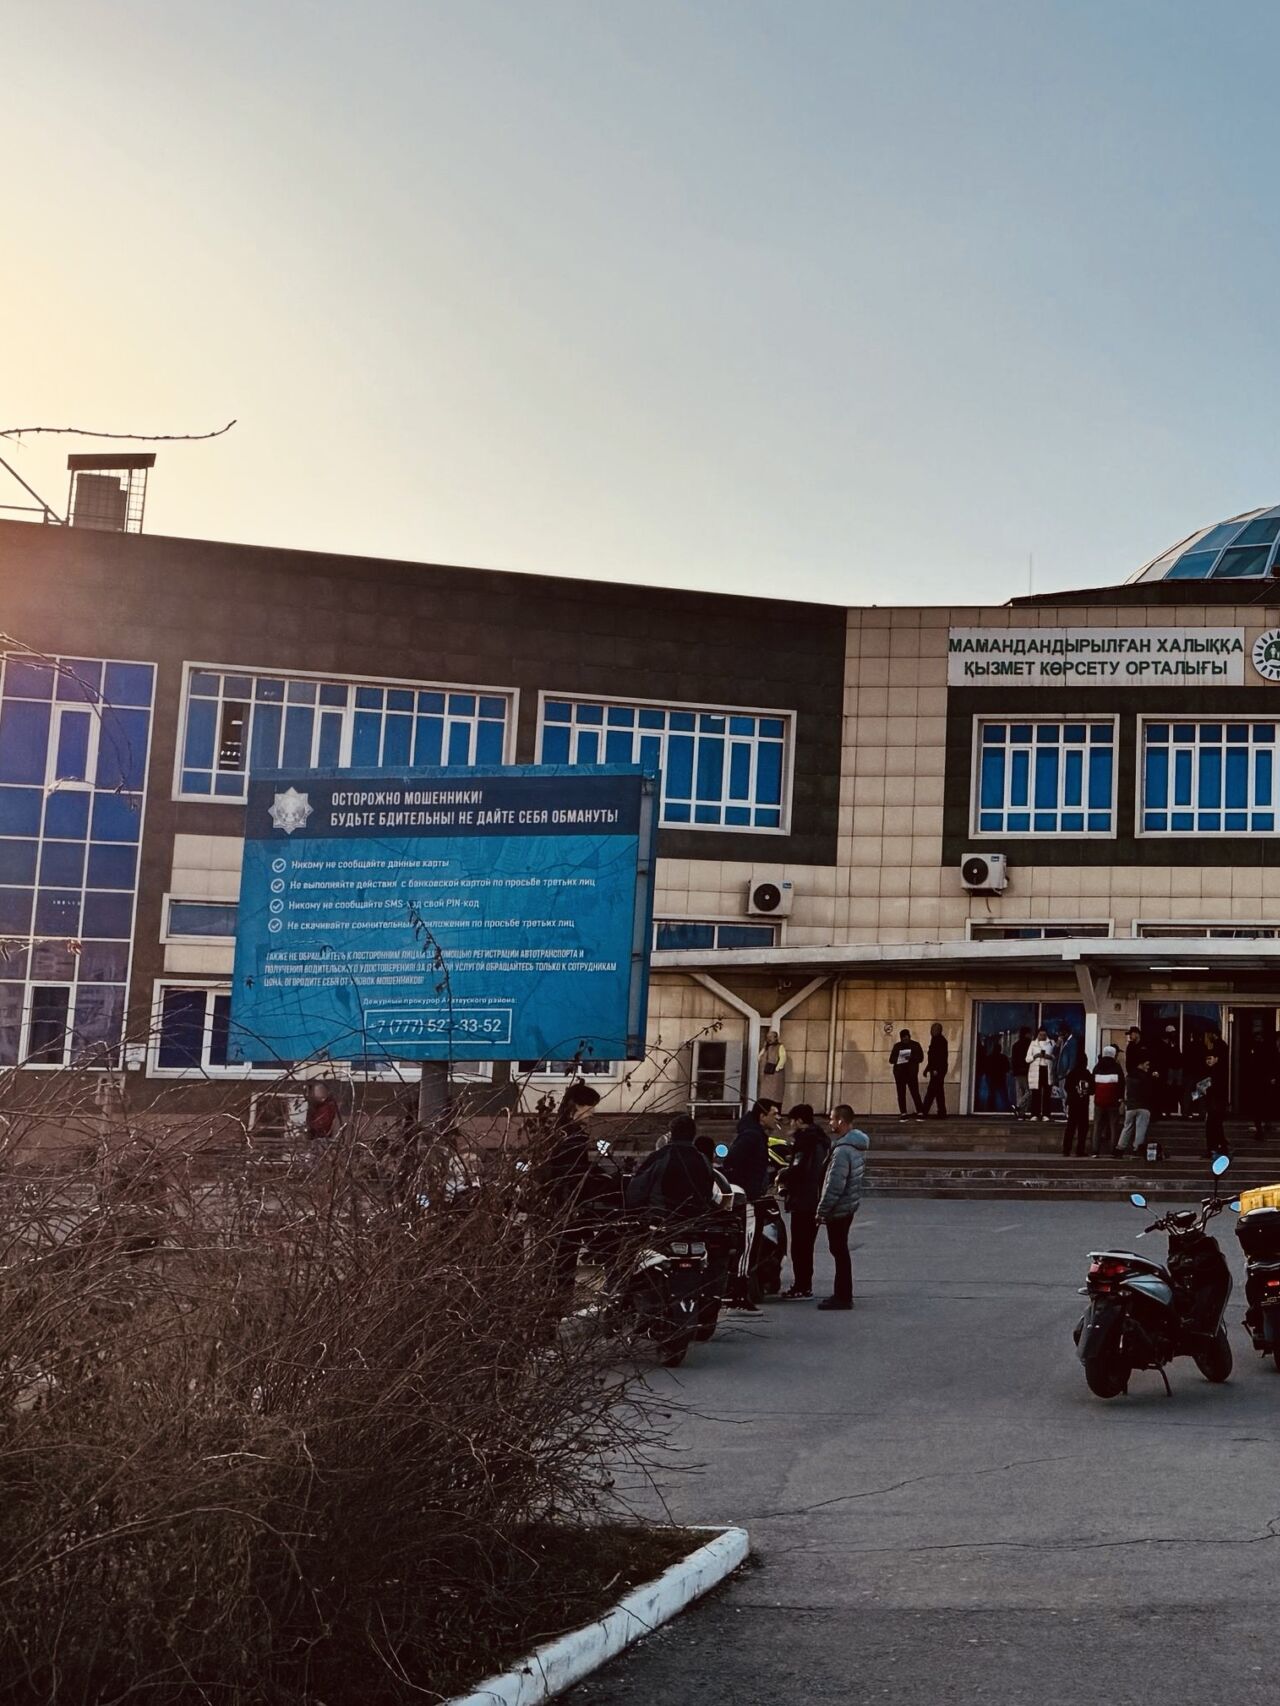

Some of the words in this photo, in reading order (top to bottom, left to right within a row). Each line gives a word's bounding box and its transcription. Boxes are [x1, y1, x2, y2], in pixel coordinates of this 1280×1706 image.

[949, 638, 1150, 655] МАМАНДАНДЫРЫЛҒАН
[1156, 638, 1244, 656] ХАЛЫҚҚА
[964, 661, 1035, 678] ҚЫЗМЕТ
[1040, 661, 1120, 676] КӨРСЕТУ
[1125, 660, 1228, 676] ОРТАЛЫҒЫ
[331, 791, 401, 806] ОСТОРОЖНО
[404, 790, 483, 805] МОШЕННИКИ!
[330, 812, 376, 828] БУДЬТЕ
[378, 811, 455, 827] БДИТЕЛЬНЫ!
[458, 811, 474, 825] НЕ
[476, 808, 516, 826] ДАЙТЕ
[518, 809, 549, 824] СЕБЯ
[551, 809, 619, 824] ОБМАНУТЬ!
[291, 860, 323, 871] Никому
[338, 859, 386, 869] сообщайте
[387, 860, 421, 869] данные
[422, 860, 450, 868] карты
[290, 881, 301, 889] Не
[303, 880, 355, 889] выполняйте
[356, 880, 397, 889] действия
[408, 879, 459, 888] банковской
[461, 879, 491, 888] картой
[505, 878, 541, 888] просьбе
[543, 879, 577, 888] третьих
[578, 879, 596, 887] лиц
[288, 901, 321, 911] Никому
[335, 900, 383, 910] сообщайте
[424, 900, 445, 908] свой
[446, 899, 479, 908] PIN-код
[288, 921, 299, 929] Не
[300, 920, 350, 929] скачивайте
[352, 920, 414, 929] сомнительны
[417, 919, 470, 929] иложения
[484, 919, 520, 928] просьбе
[522, 919, 557, 928] третьих
[558, 920, 575, 928] лиц
[427, 963, 454, 972] ДОЙ
[389, 1019, 423, 1035] (777)
